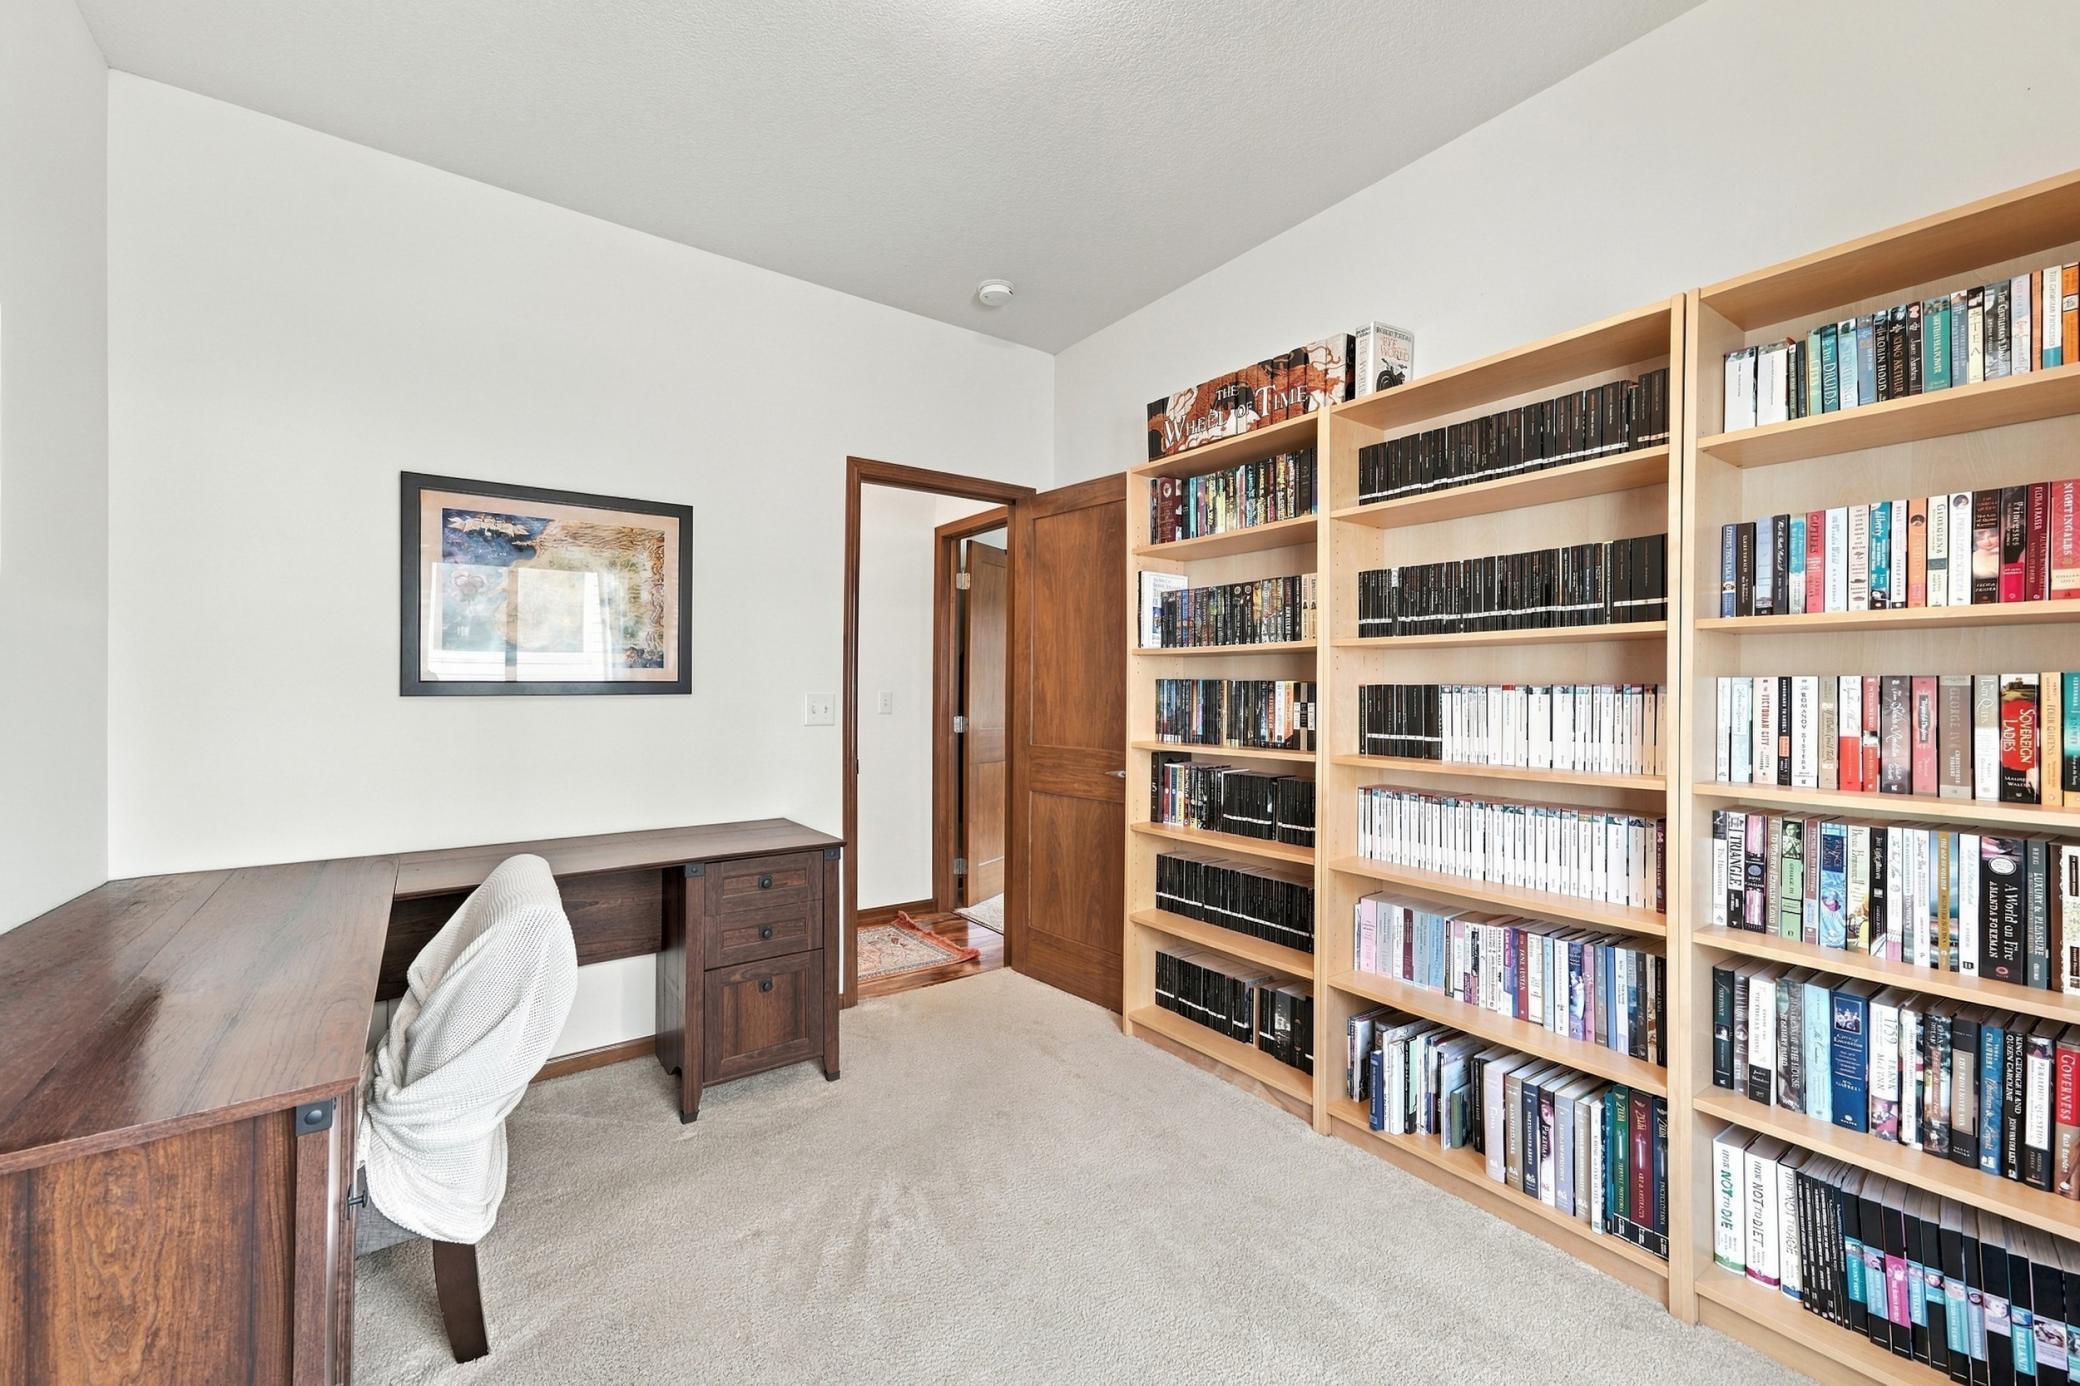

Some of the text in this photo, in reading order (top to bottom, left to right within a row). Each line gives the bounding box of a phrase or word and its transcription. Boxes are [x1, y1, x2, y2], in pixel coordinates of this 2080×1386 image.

[1876, 337, 1888, 391] ROBIN HOOD
[1215, 385, 1239, 400] THE
[1822, 362, 1838, 405] DRUIDS
[1163, 383, 1308, 446] WHEEL OF TIME
[1936, 503, 1946, 554] GEORGIANA
[2012, 501, 2025, 547] Princesses
[2063, 481, 2074, 557] NIGHTINGALES
[1761, 694, 1770, 746] VICTORIAN CITY
[1948, 687, 1961, 728] GEORGE
[2002, 719, 2019, 752] LADIES
[2018, 708, 2036, 764] SOVEREIGN
[1729, 835, 1743, 886] TRIANGLE
[1769, 843, 1779, 869] MARRY
[2034, 872, 2044, 905] LUXURY
[1769, 905, 1777, 924] LORD
[1988, 881, 1998, 959] AMANDA FOREMAN
[2003, 884, 2018, 961] A World on Fire
[2034, 916, 2045, 957] PLEASURE
[1883, 1018, 1898, 1046] 1759
[2015, 1036, 2024, 1055] KING
[1790, 1045, 1800, 1061] THE
[1985, 1032, 1995, 1070] CHAMBERS
[2006, 1034, 2015, 1101] QUEEN CAROLINE
[1790, 1062, 1800, 1088] HOUSE
[1888, 1060, 1897, 1090] FRANK
[2015, 1057, 2023, 1088] GEORGE
[2059, 1053, 2077, 1121] GOVERNESS
[1617, 1101, 1626, 1122] ZELDA
[1635, 1109, 1646, 1131] ZELDA
[2014, 1097, 2022, 1114] AND
[1752, 1182, 1764, 1207] NOT
[1720, 1208, 1733, 1231] DIE
[1752, 1218, 1764, 1248] DIET
[1785, 1231, 1798, 1255] AGE
[2016, 1330, 2029, 1371] IRELAND
